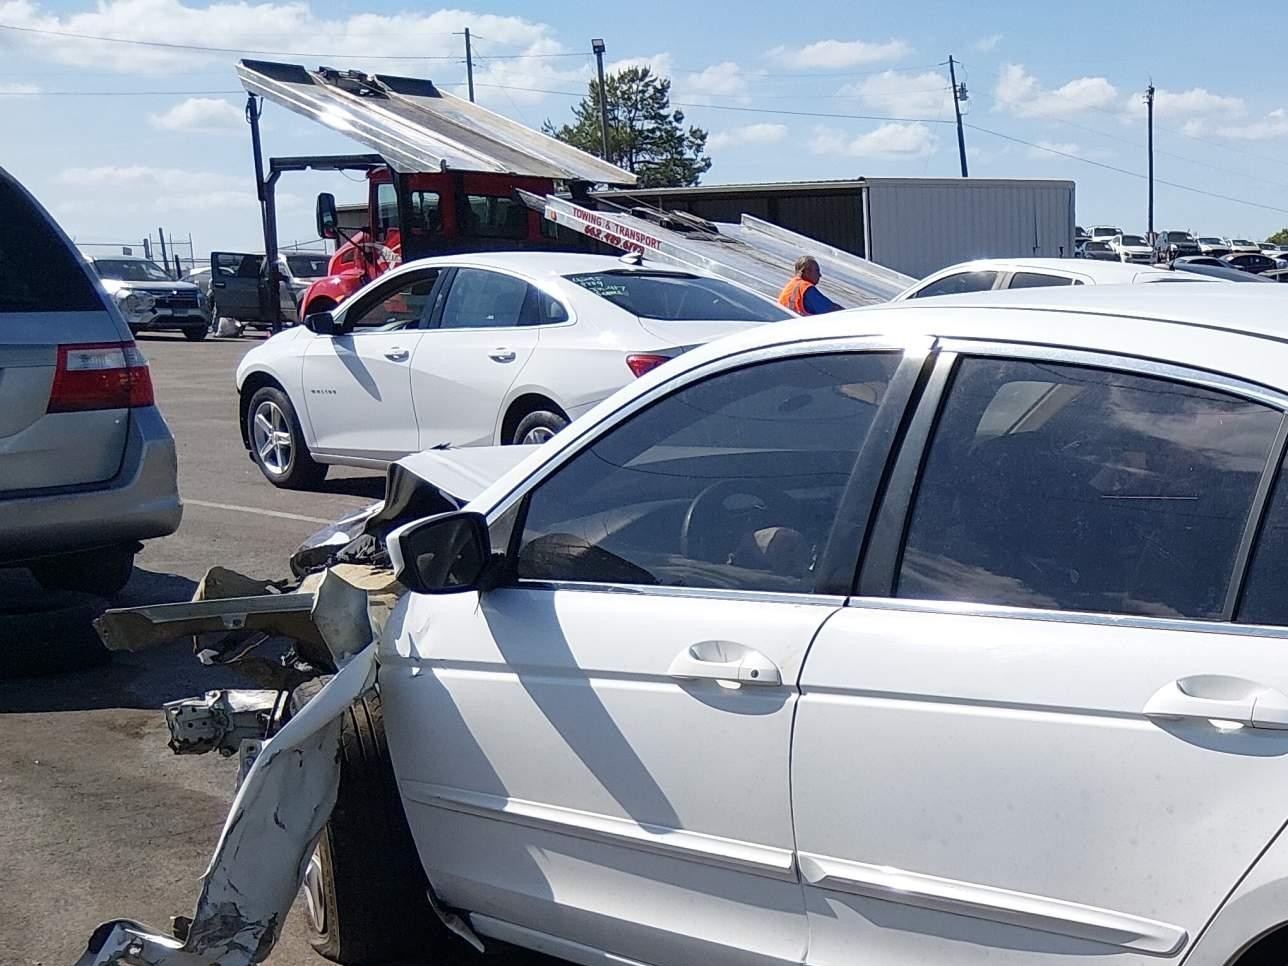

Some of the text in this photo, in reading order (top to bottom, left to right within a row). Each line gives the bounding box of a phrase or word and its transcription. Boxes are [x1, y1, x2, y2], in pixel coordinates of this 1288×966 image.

[572, 206, 662, 250] TOWING & TRANSPORT
